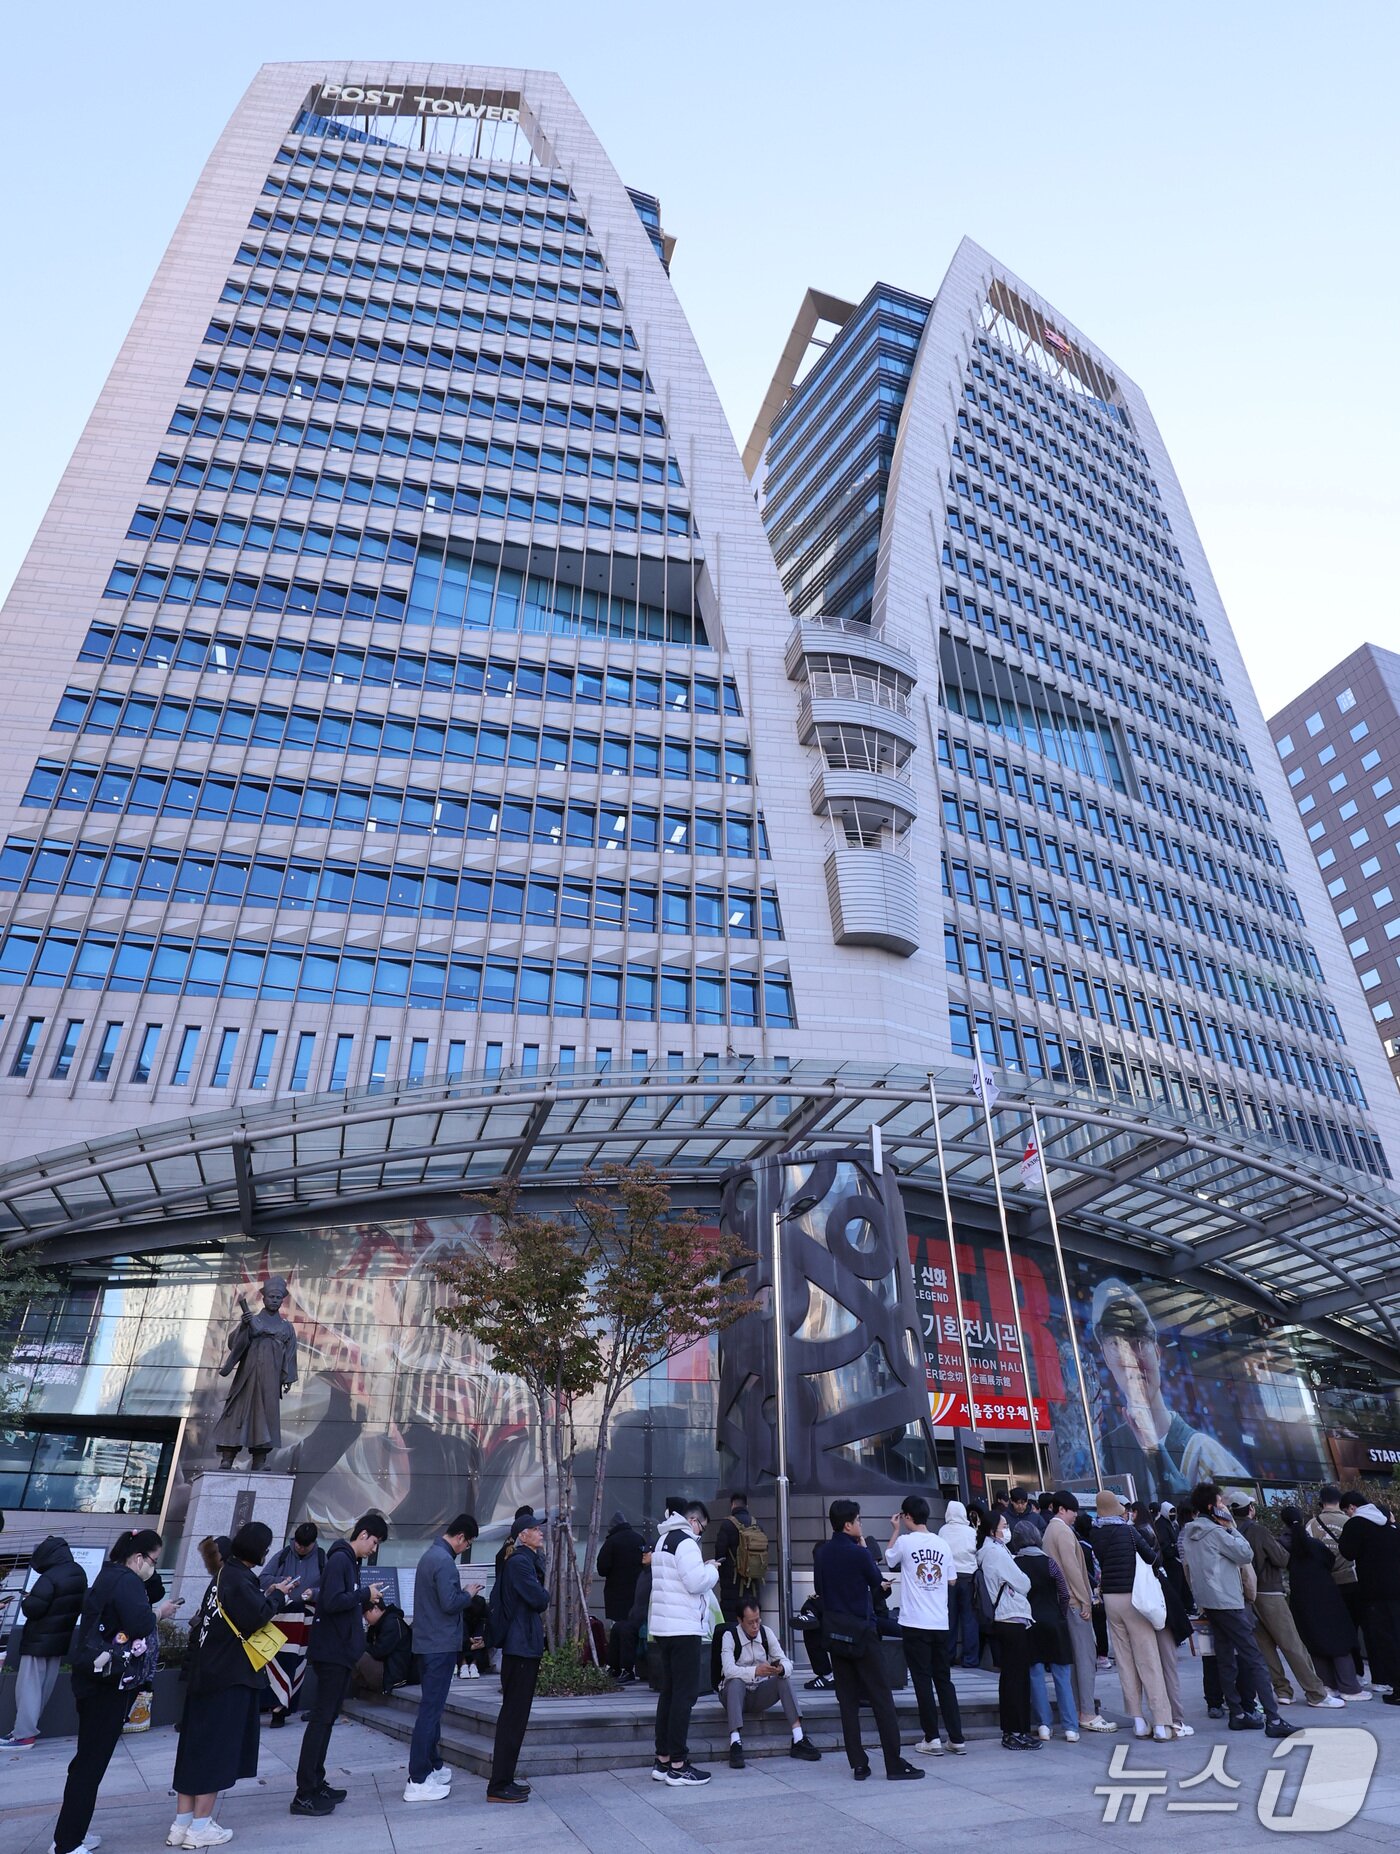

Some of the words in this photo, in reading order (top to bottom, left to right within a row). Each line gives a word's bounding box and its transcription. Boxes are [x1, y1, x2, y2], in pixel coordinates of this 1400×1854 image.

[321, 84, 404, 108] POST
[414, 95, 520, 123] TOWER
[921, 1266, 947, 1288] 신화
[938, 1354, 997, 1370] EXHIITION
[911, 1549, 944, 1566] SEOUL
